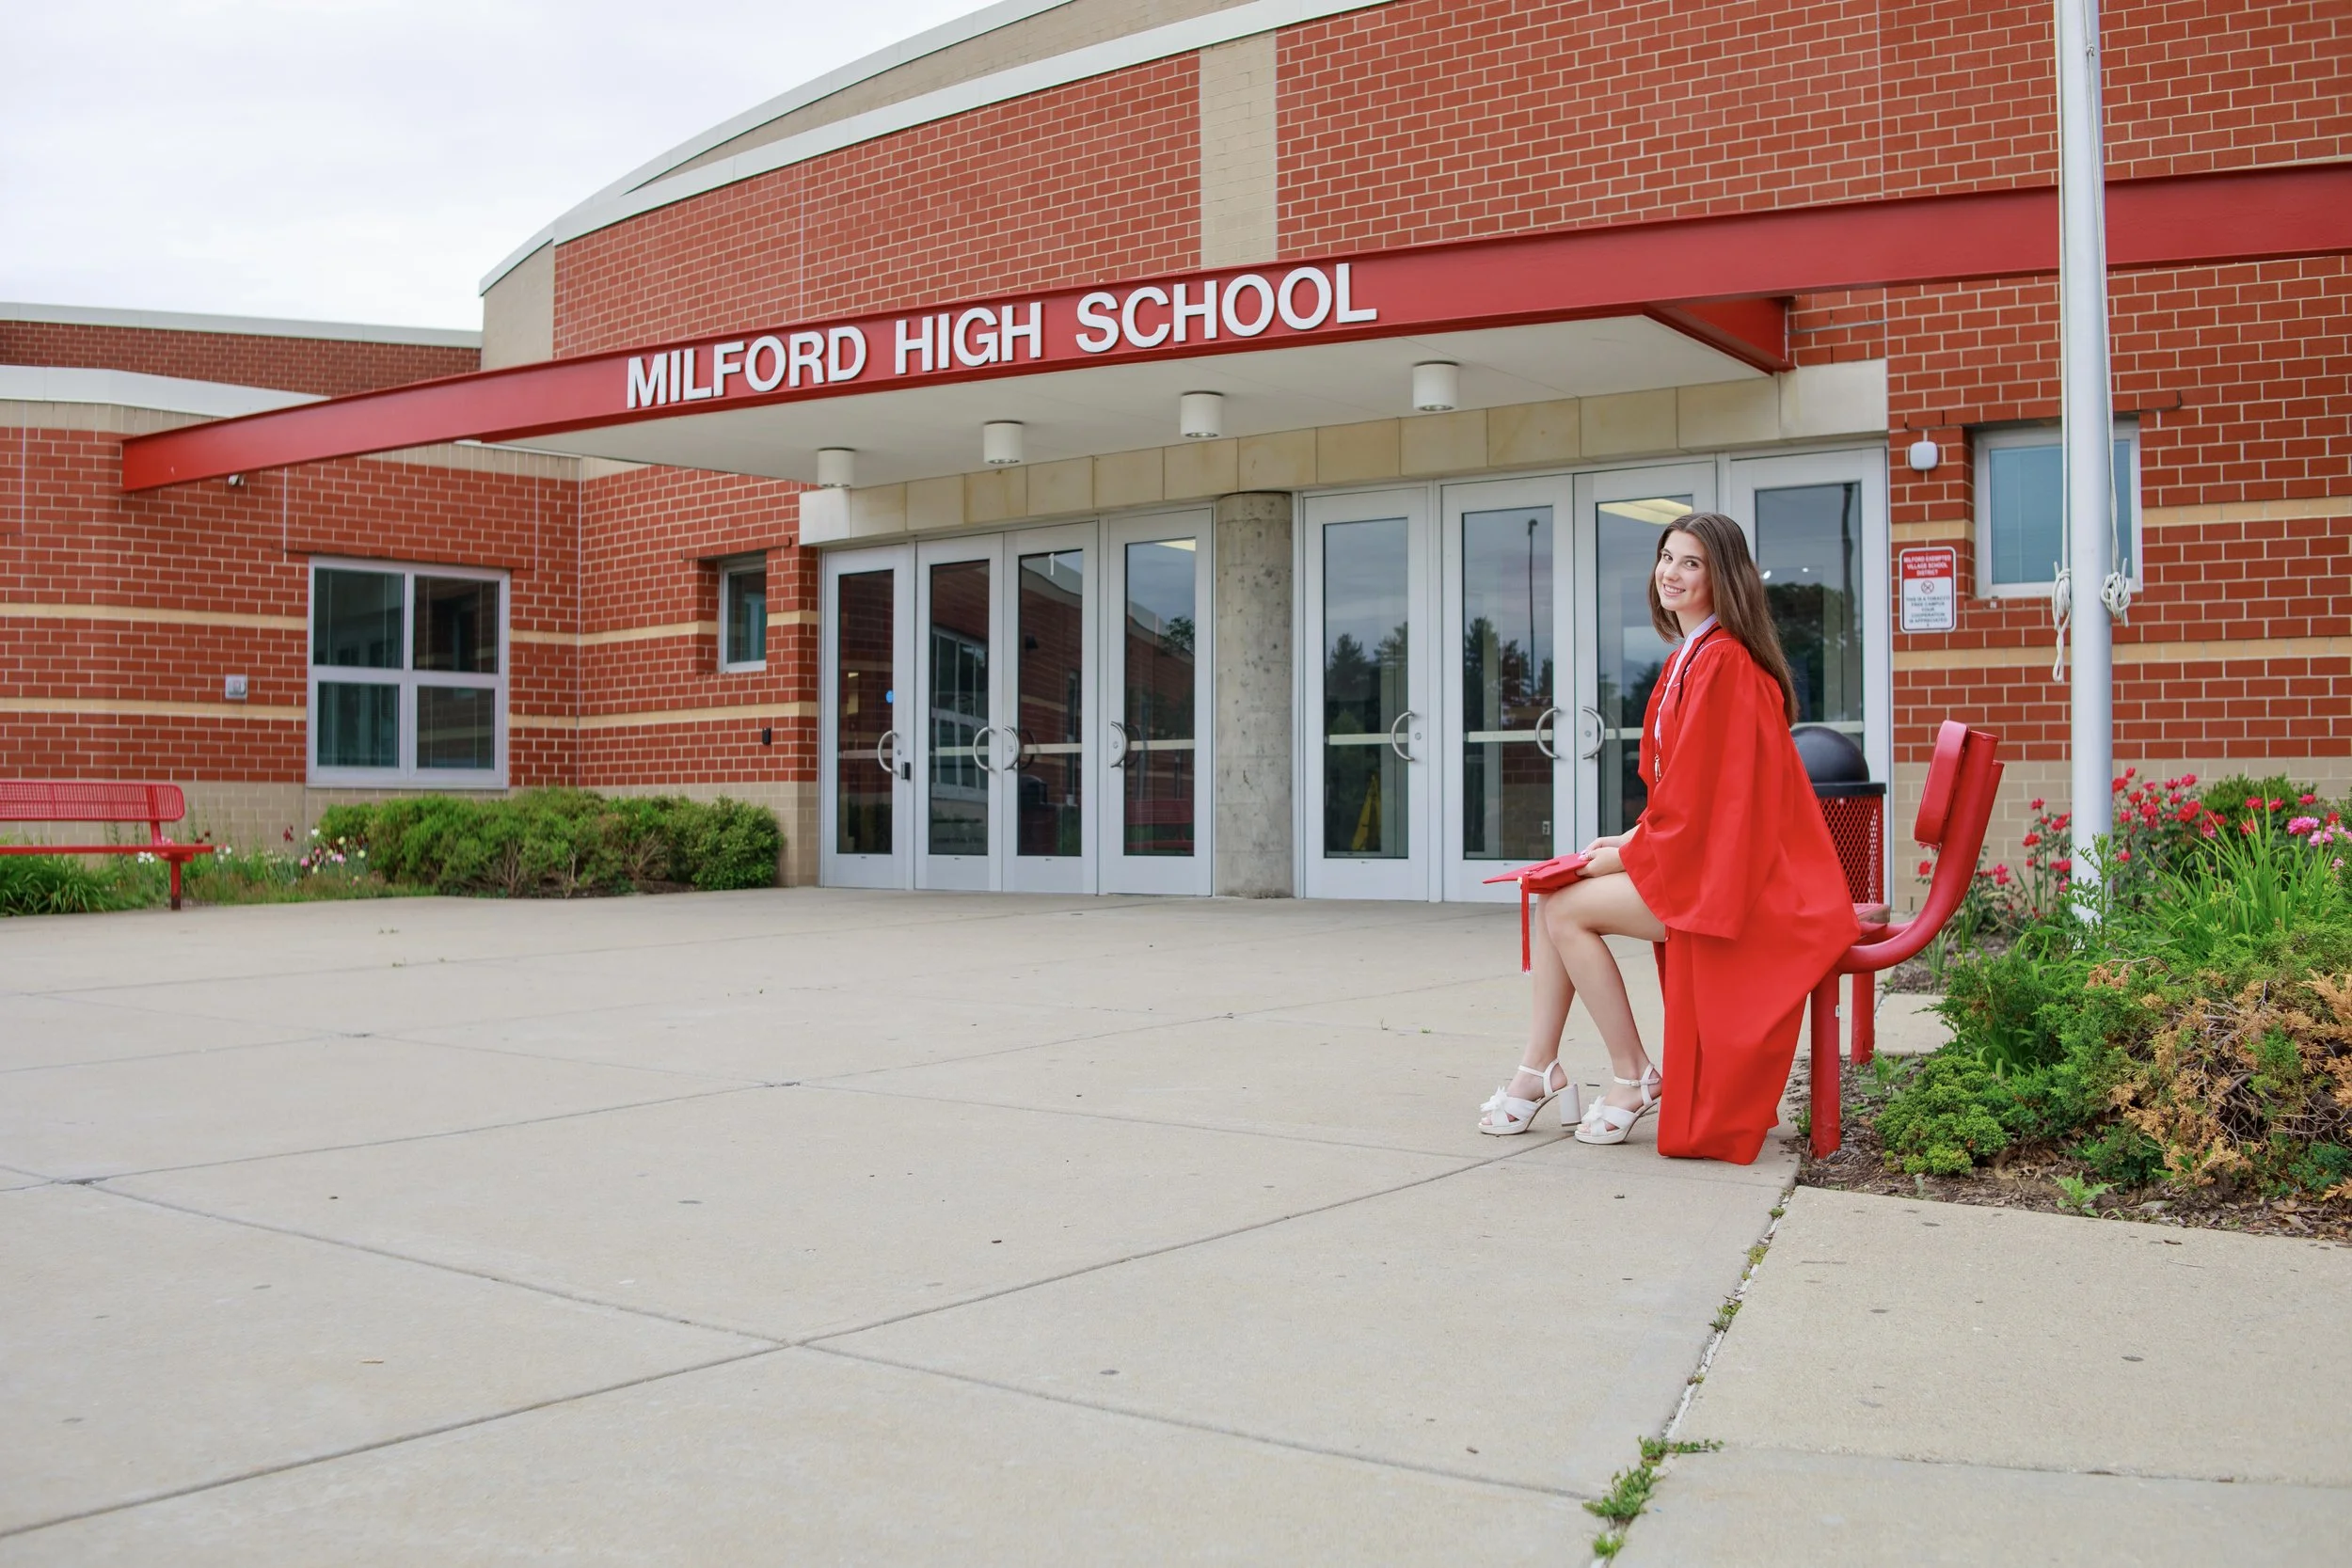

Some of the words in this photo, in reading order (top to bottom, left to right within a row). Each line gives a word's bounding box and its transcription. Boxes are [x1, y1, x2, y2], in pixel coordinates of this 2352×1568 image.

[627, 325, 867, 409] MILFORD
[896, 301, 1041, 375] HIGH
[1075, 262, 1378, 354] SCHOOL
